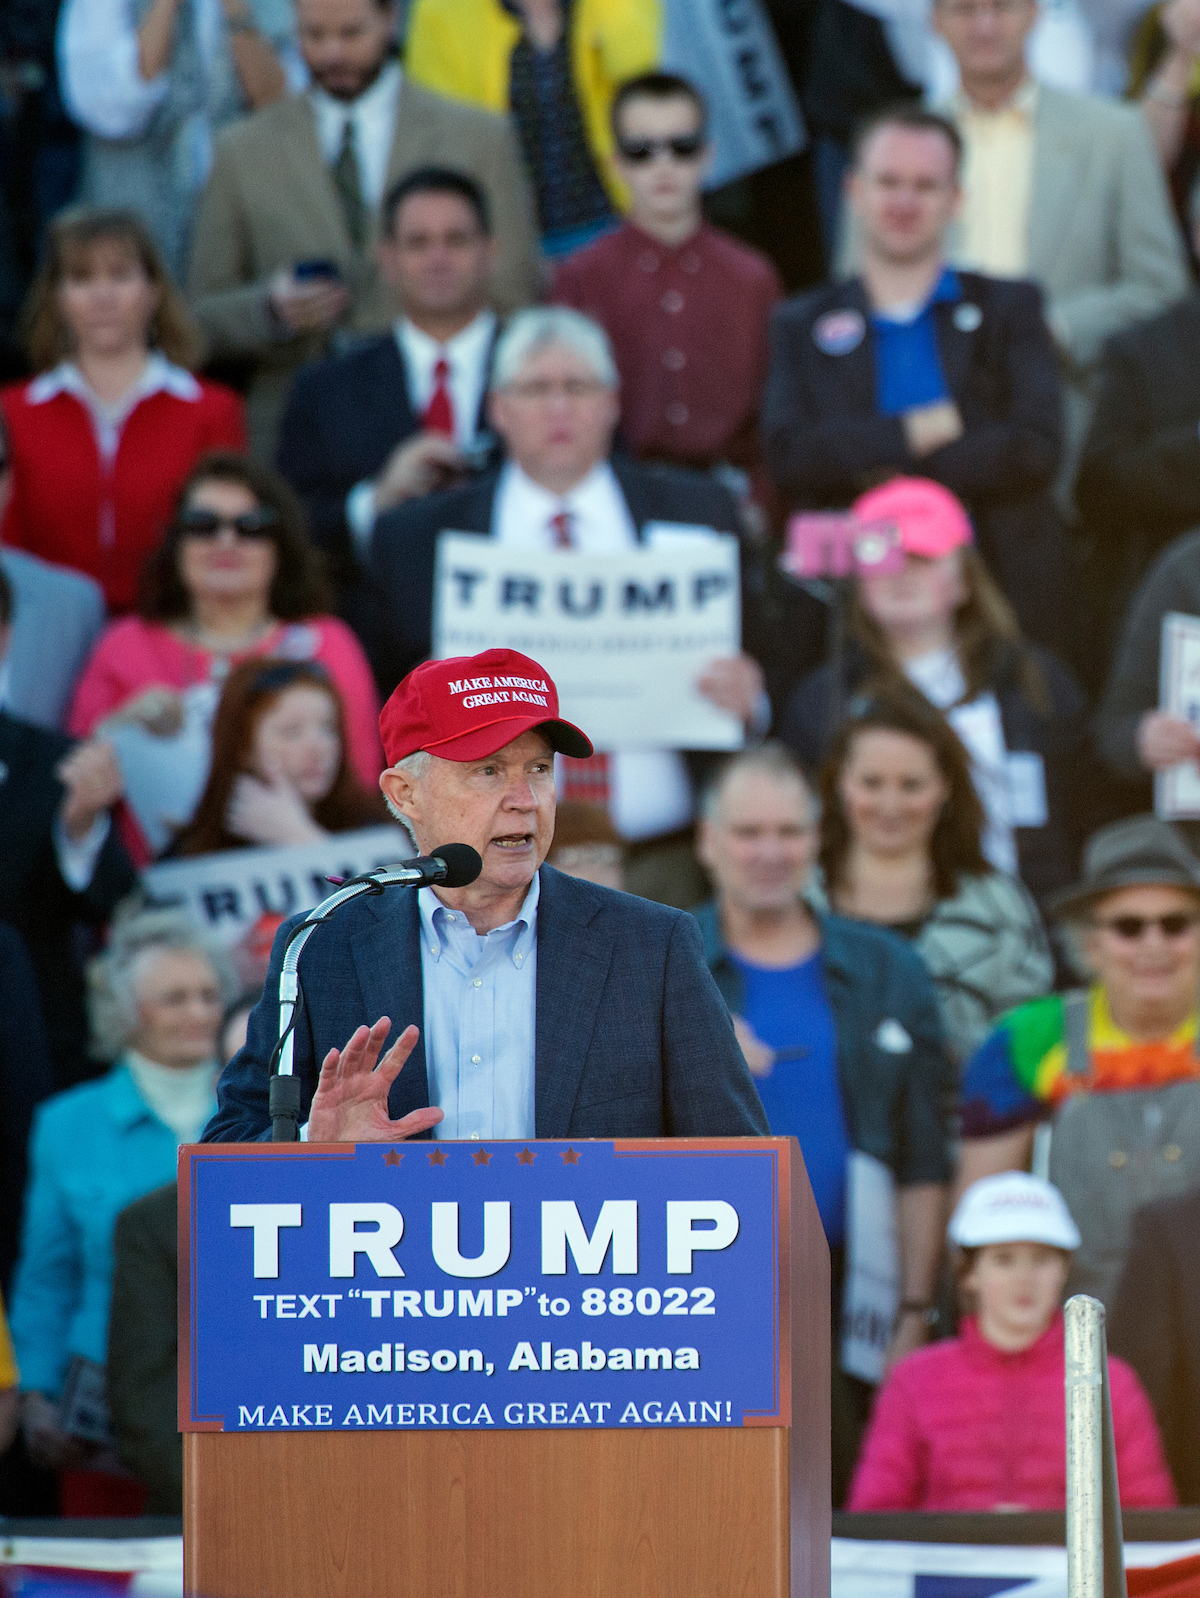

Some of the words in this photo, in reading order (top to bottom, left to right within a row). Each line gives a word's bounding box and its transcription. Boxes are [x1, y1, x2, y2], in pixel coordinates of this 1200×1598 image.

[452, 568, 731, 619] TRUMP
[448, 677, 493, 695] MAKE
[494, 676, 550, 693] AMERICA
[462, 691, 511, 709] GREAT
[512, 691, 548, 708] AGAIN
[230, 1200, 740, 1279] TRUMP
[253, 1294, 343, 1319] TEXT
[537, 1292, 571, 1317] to
[580, 1286, 716, 1316] 88022
[303, 1342, 496, 1377] Madison,
[508, 1341, 701, 1372] Alabama
[238, 1405, 334, 1428] MAKE
[342, 1402, 495, 1427] AMERICA
[503, 1402, 612, 1425] GREAT
[619, 1400, 734, 1424] AGAIN!
